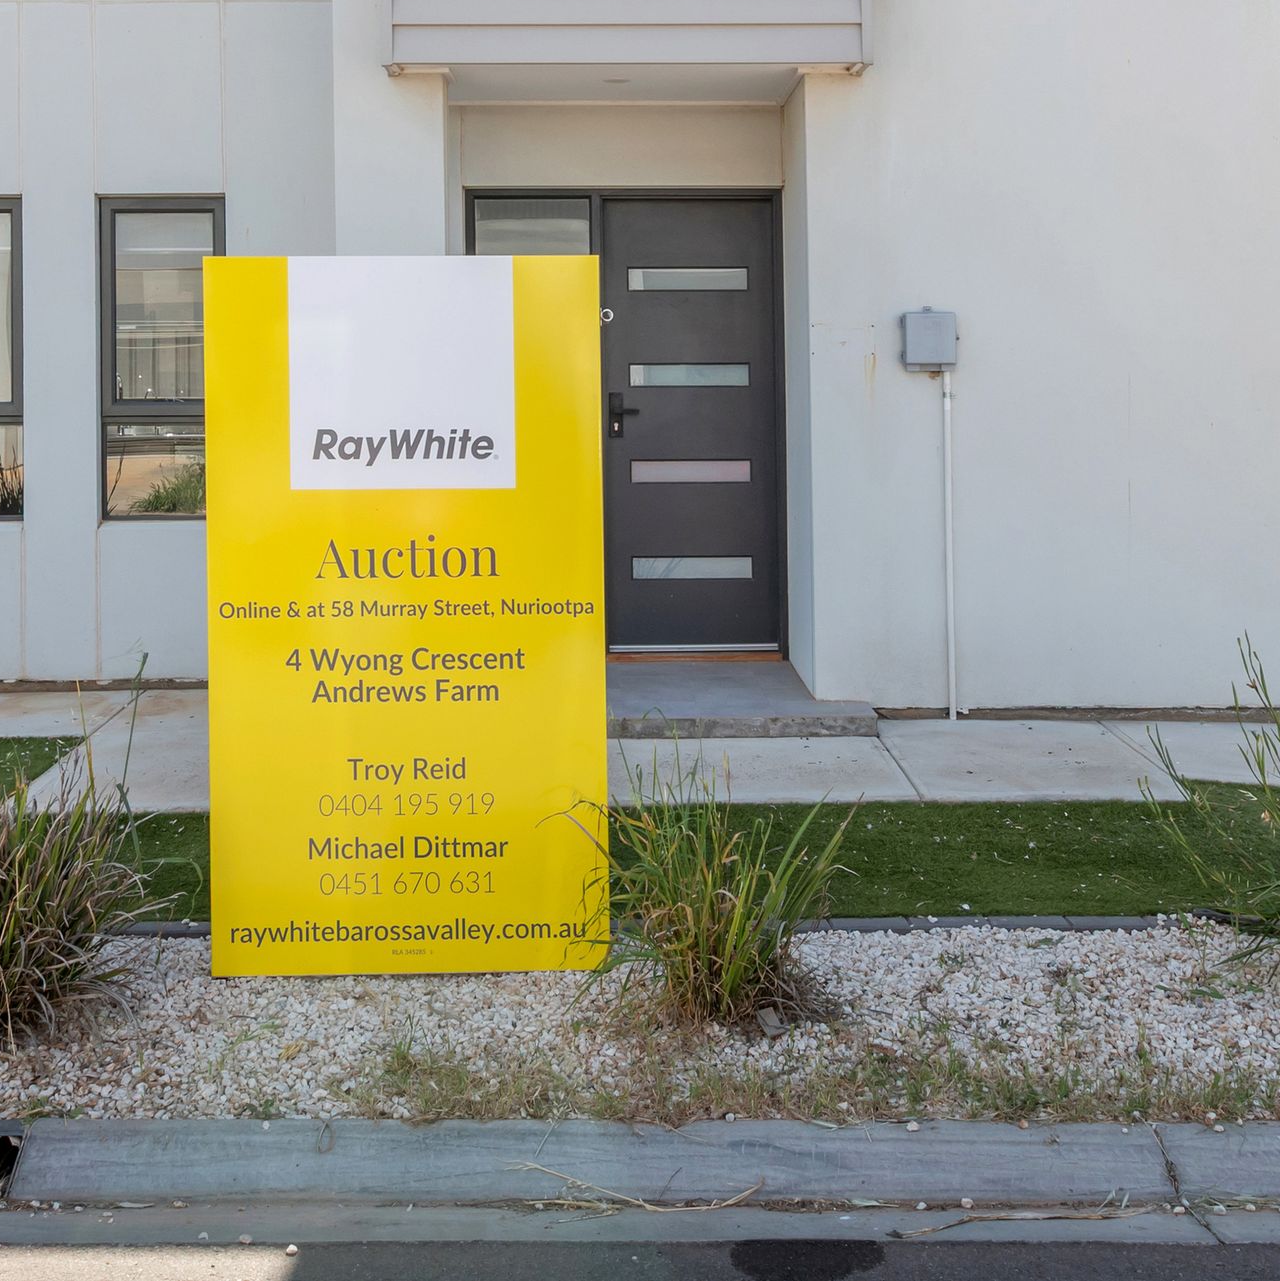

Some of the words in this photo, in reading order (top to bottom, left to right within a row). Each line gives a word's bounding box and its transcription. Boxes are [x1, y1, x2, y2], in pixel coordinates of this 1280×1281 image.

[314, 534, 501, 580] Auction
[218, 601, 281, 619] Online
[286, 601, 302, 618] &
[306, 601, 326, 618] at
[330, 600, 355, 618] 58
[360, 599, 428, 620] Murray
[433, 599, 495, 618] Street,
[500, 597, 595, 618] Nuriootpa
[285, 648, 303, 671] 4
[309, 648, 404, 677] Wyong
[411, 646, 526, 671] Crescent
[311, 678, 427, 704] Andrews
[435, 678, 500, 702] Farm
[346, 757, 405, 786] Troy
[413, 756, 467, 780] Reid
[318, 793, 384, 817] 0404
[393, 793, 439, 816] 195
[448, 792, 496, 816] 919
[308, 835, 405, 860] Michael
[413, 835, 509, 859] Dittmar
[319, 872, 384, 896] 0451
[393, 871, 441, 895] 670
[449, 871, 496, 894] 631
[230, 918, 585, 945] raywhitebarossavalley.com.au
